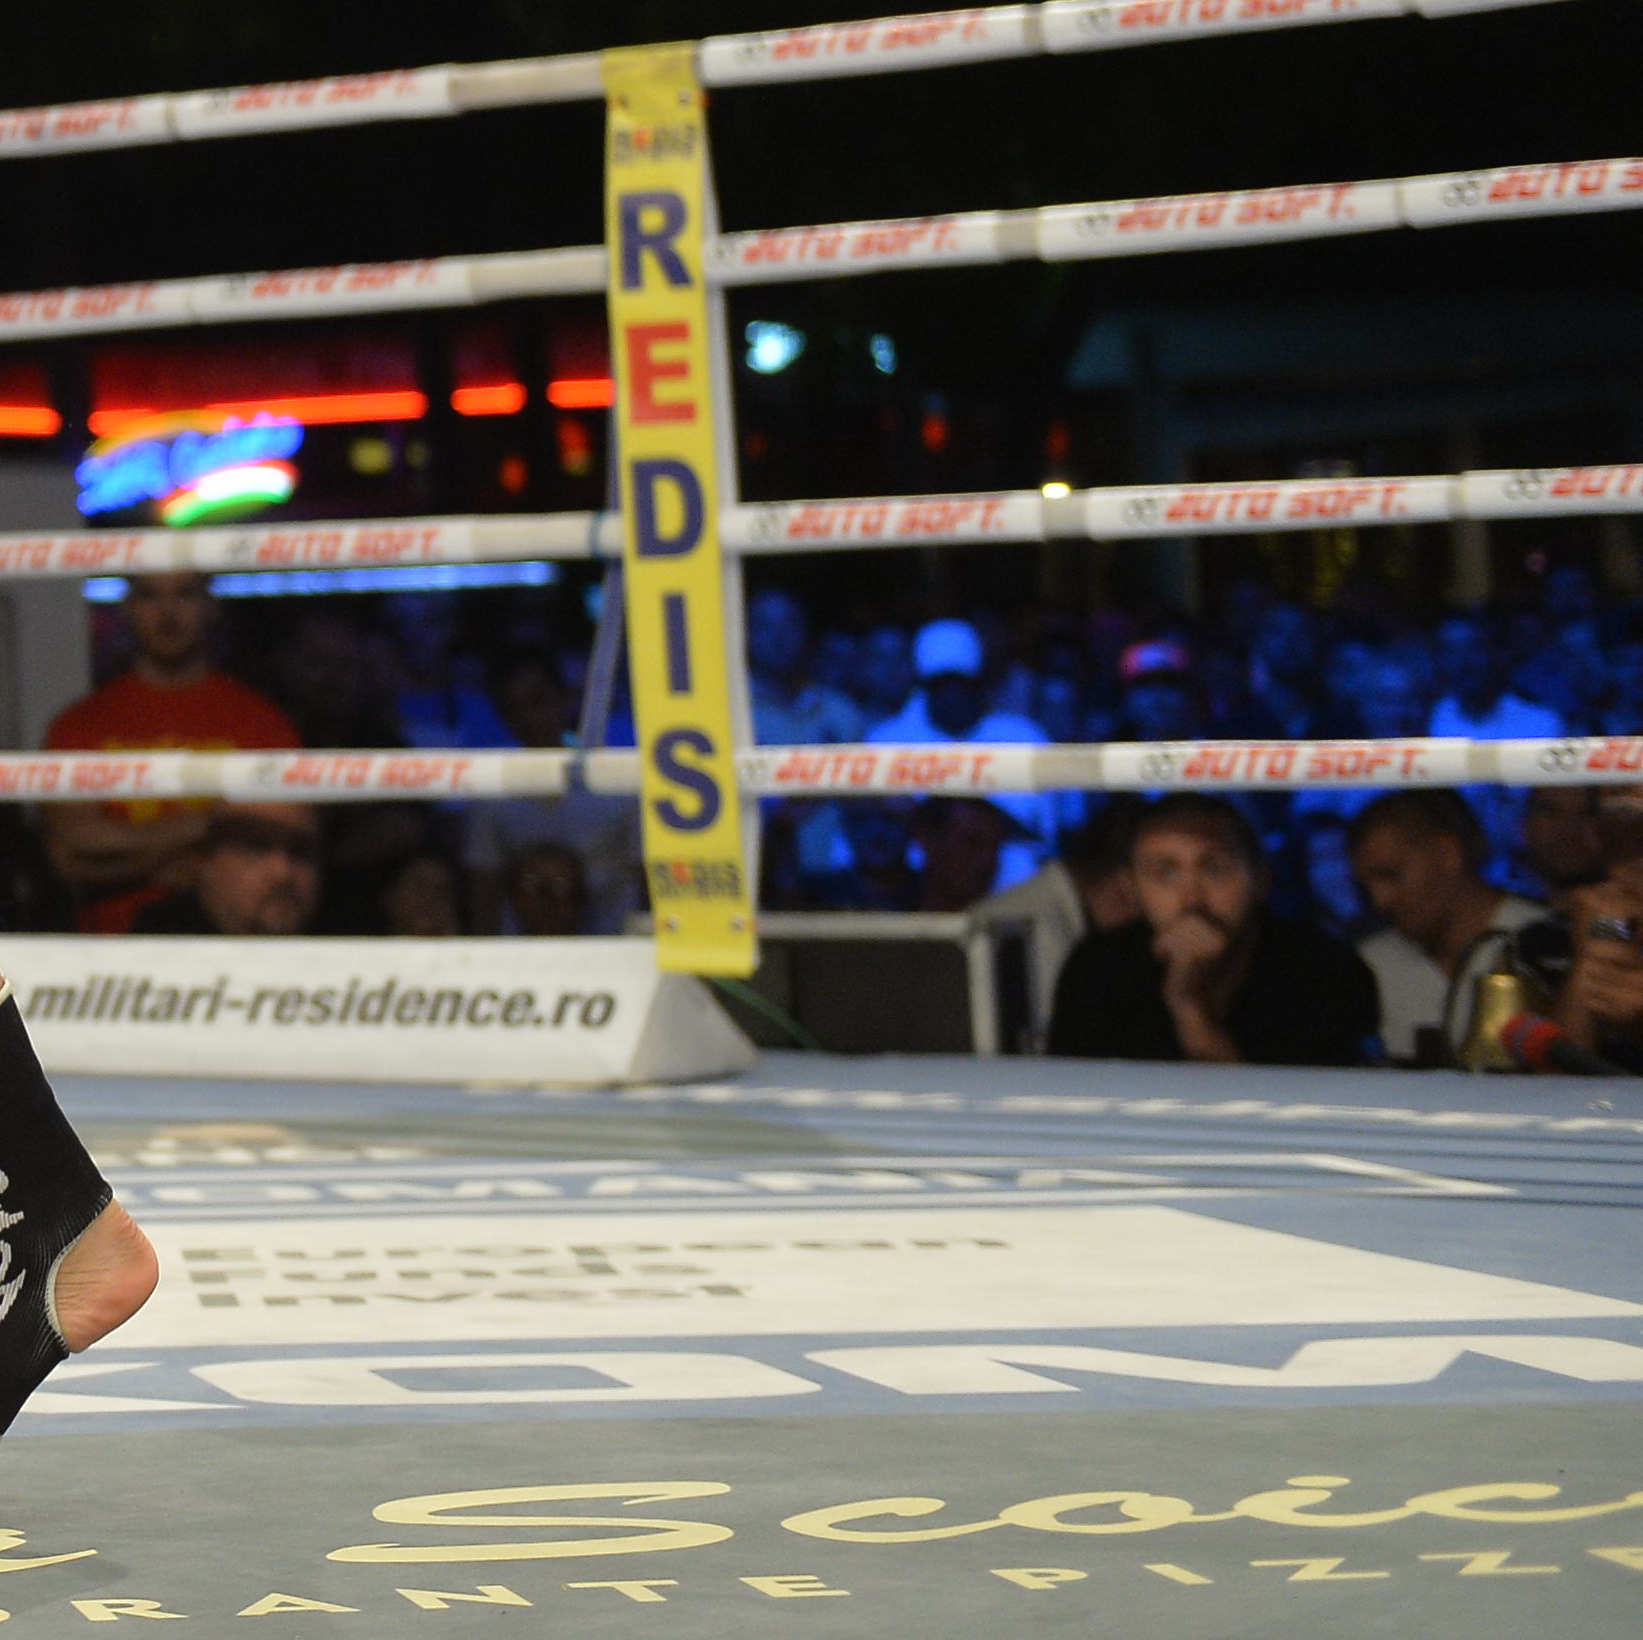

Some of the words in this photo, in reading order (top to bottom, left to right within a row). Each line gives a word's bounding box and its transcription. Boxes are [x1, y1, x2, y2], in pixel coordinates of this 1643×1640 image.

[616, 189, 726, 835] REDIS
[1549, 464, 1643, 498] AUT
[1182, 743, 1300, 781] AUTO
[325, 1474, 1643, 1565] Scoic
